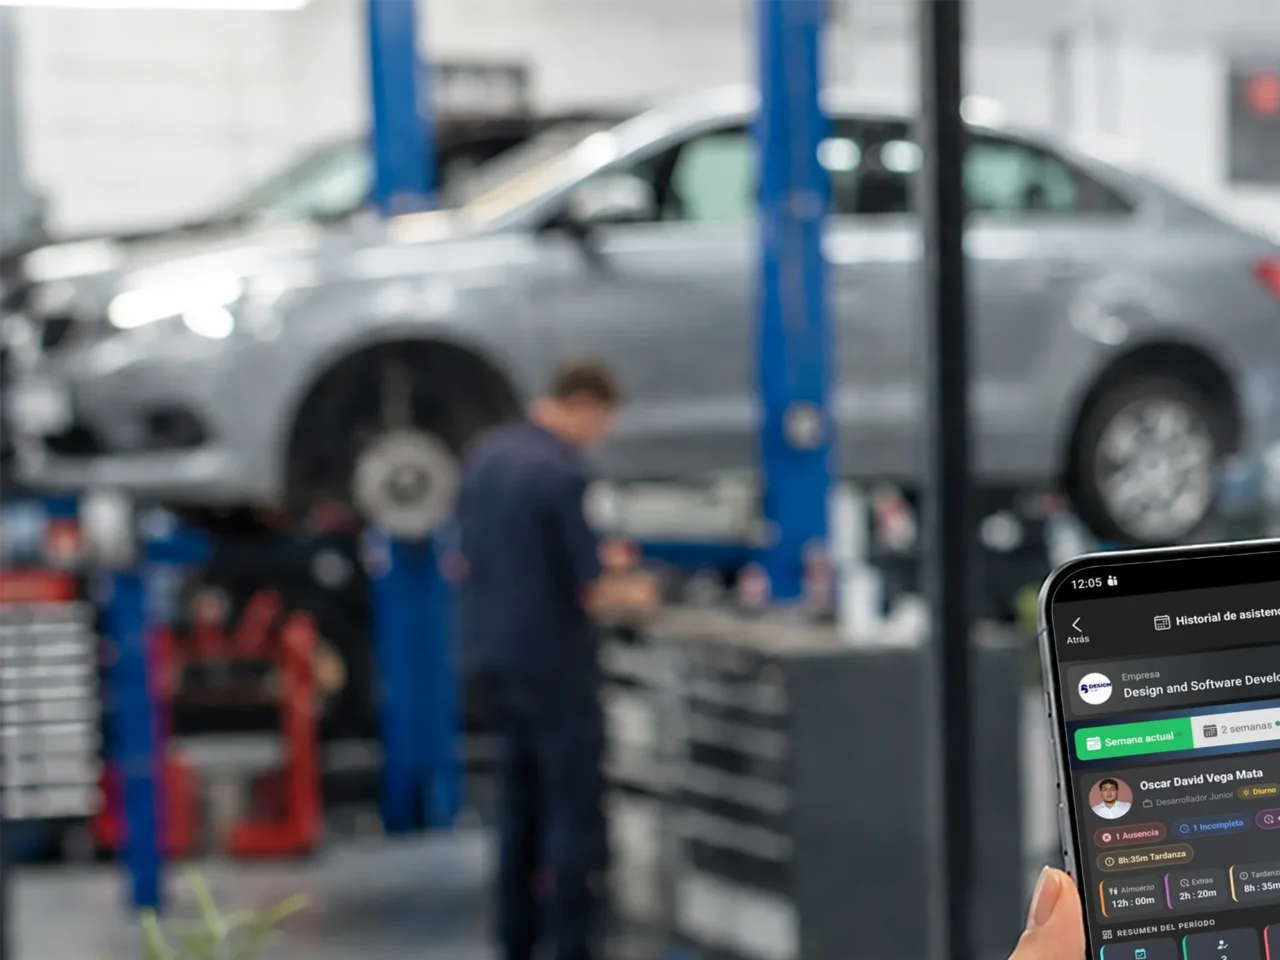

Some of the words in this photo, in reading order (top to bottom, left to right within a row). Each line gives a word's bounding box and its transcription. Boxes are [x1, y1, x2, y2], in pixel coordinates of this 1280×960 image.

[1071, 578, 1102, 589] 12:05
[1176, 612, 1221, 626] Historial
[1224, 611, 1237, 621] de
[1067, 634, 1090, 644] Atrás
[1122, 671, 1160, 682] Empresa
[1124, 686, 1164, 698] Design
[1166, 682, 1188, 694] and
[1191, 678, 1242, 691] Software
[1221, 726, 1228, 734] 2
[1230, 722, 1273, 733] semanas
[1105, 736, 1143, 747] Semana
[1145, 732, 1174, 742] actual
[1140, 779, 1171, 791] Oscar
[1173, 774, 1204, 787] David
[1206, 773, 1234, 784] Vega
[1236, 769, 1264, 780] Mata
[1252, 787, 1277, 796] Diurno
[1156, 795, 1208, 807] Desarrollador
[1209, 791, 1234, 801] Junior
[1199, 820, 1244, 831] Incompleta
[1122, 828, 1159, 840] Ausencia
[1118, 854, 1149, 865] 8h:35m
[1150, 851, 1186, 861] Tardanza
[1191, 878, 1214, 886] Extras
[1244, 884, 1256, 893] 8h
[1262, 882, 1280, 891] 35m
[1121, 884, 1155, 894] Almuerzo
[1179, 891, 1191, 901] 2h
[1198, 890, 1217, 898] 20m
[1112, 899, 1129, 908] 12h
[1135, 897, 1155, 906] 00m
[1117, 926, 1158, 937] RESUMEN
[1160, 924, 1176, 932] DEL
[1178, 919, 1216, 930] PERÍODO
